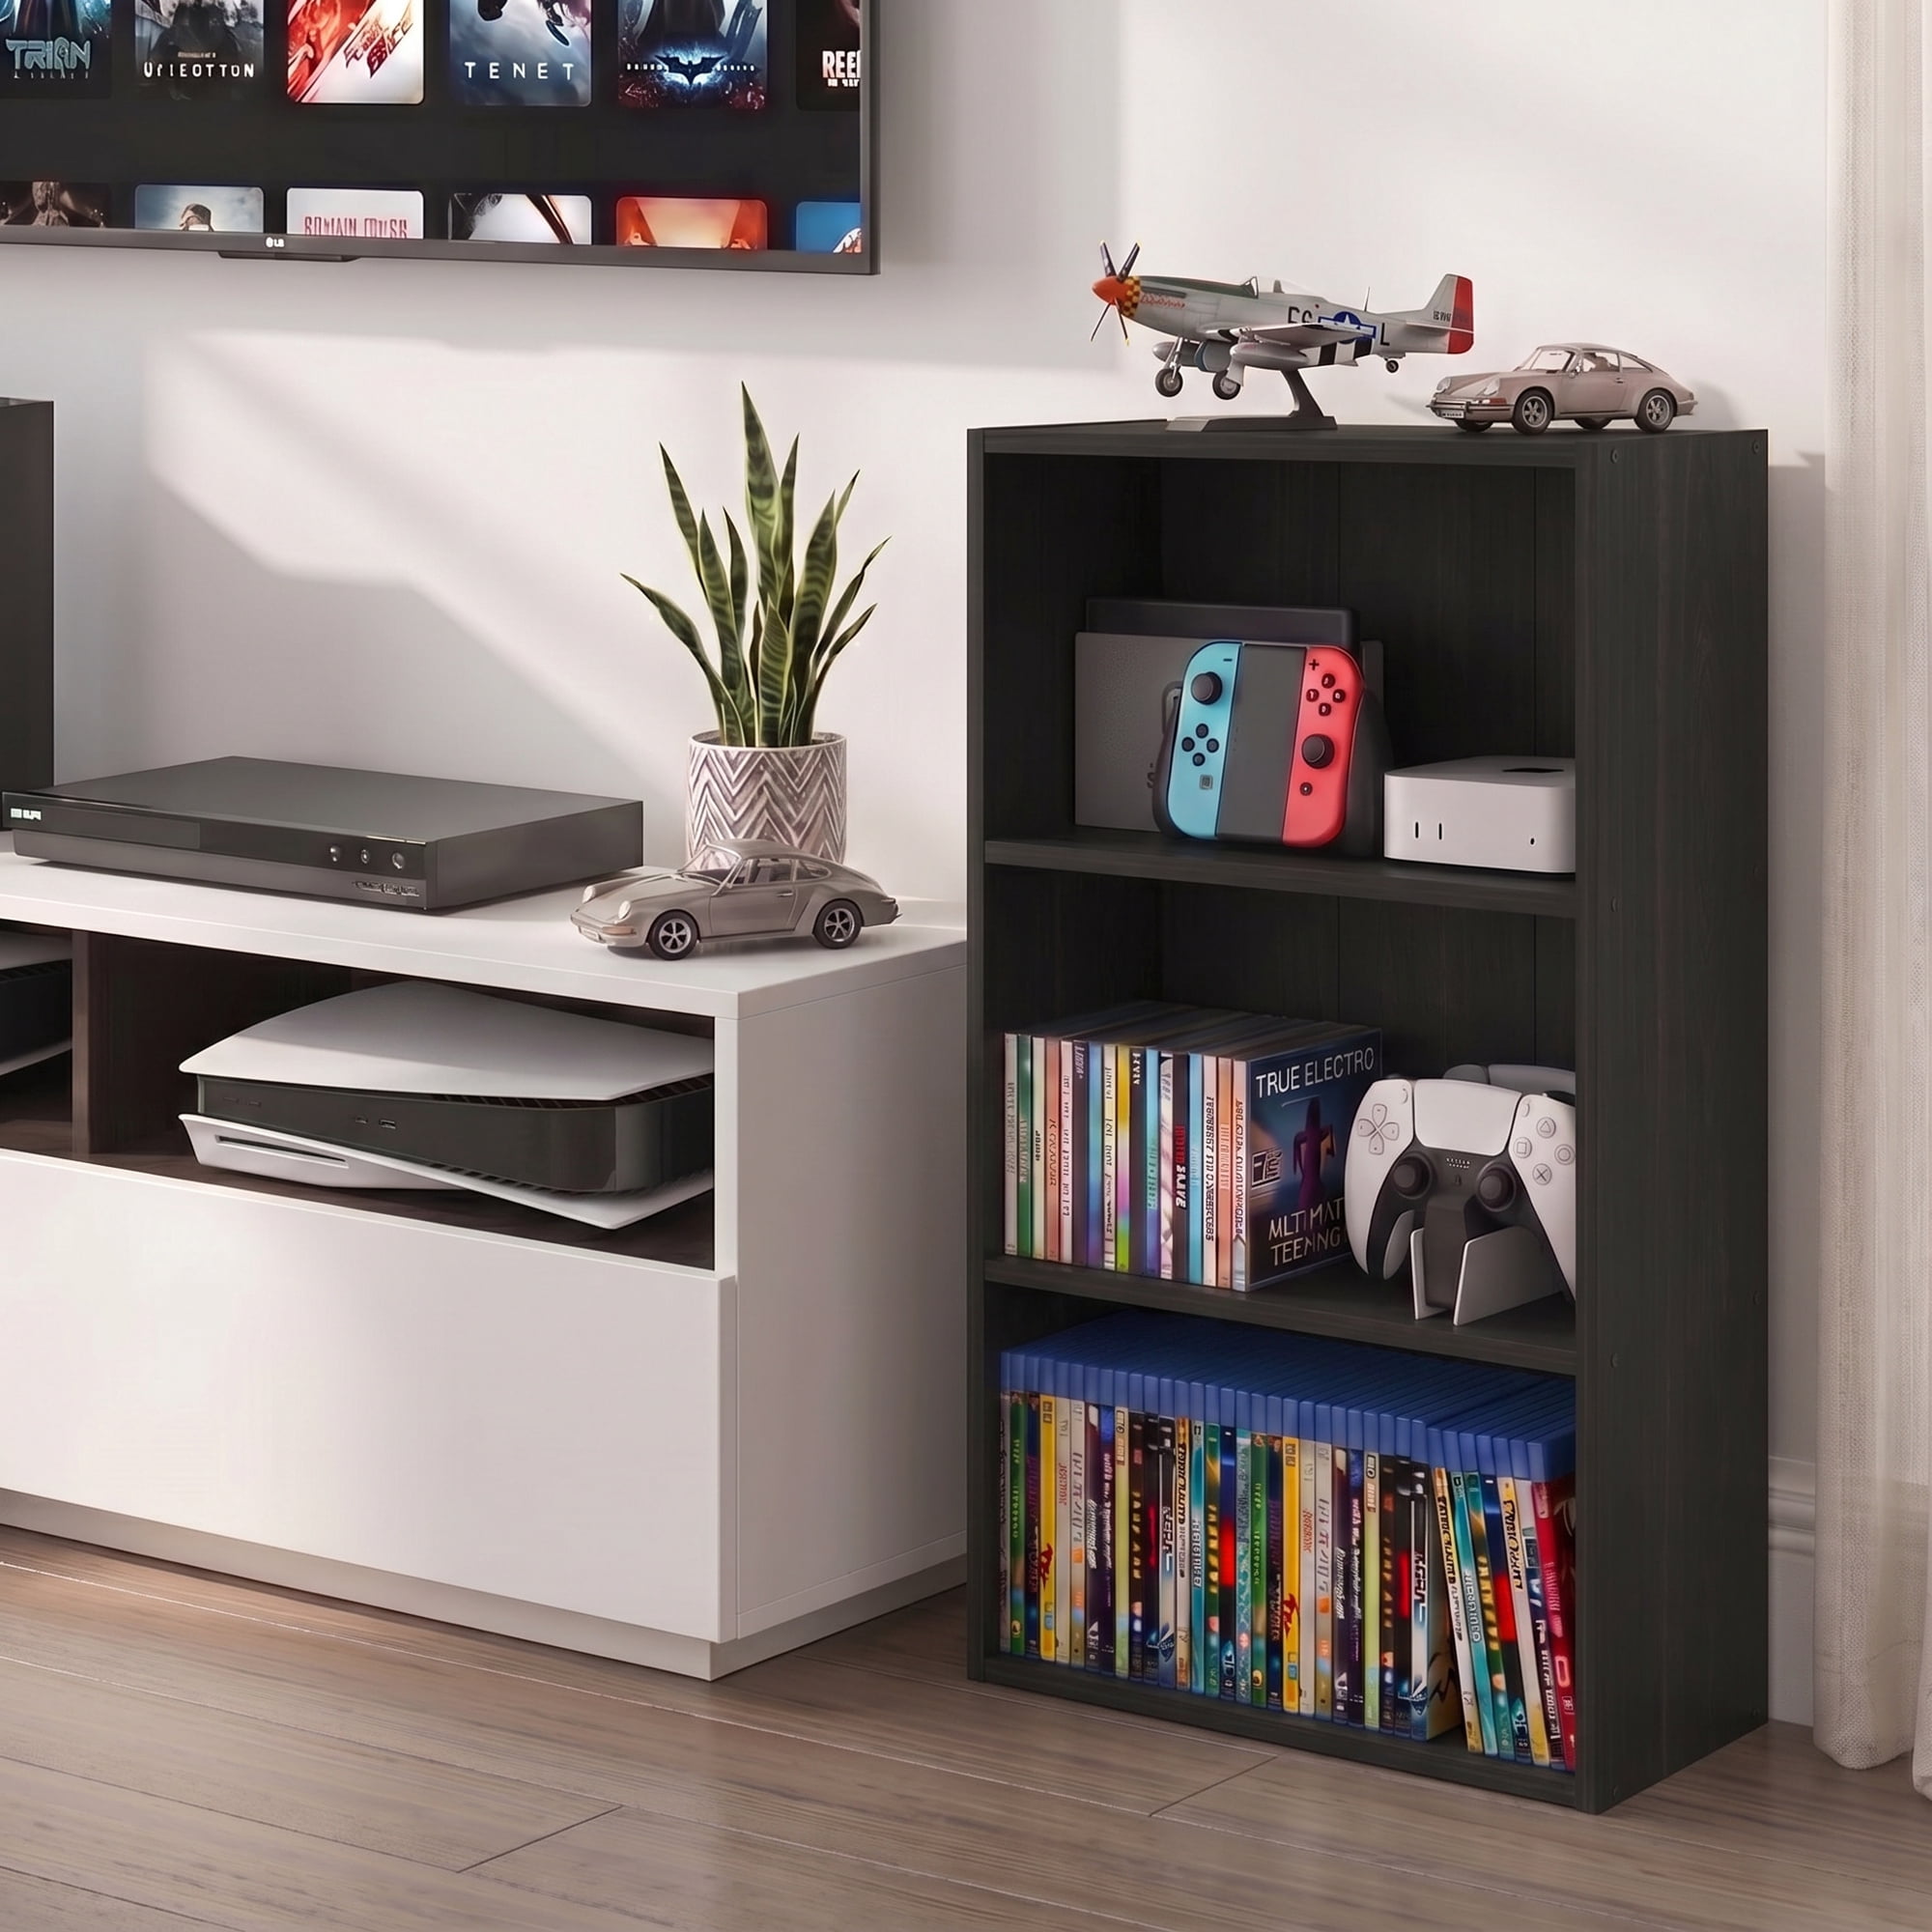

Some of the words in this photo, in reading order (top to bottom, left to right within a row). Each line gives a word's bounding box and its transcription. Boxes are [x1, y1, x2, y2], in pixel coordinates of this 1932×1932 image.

[464, 62, 575, 80] TENET
[1256, 1065, 1300, 1098] TRUE
[1304, 1047, 1375, 1087] ELECTRO
